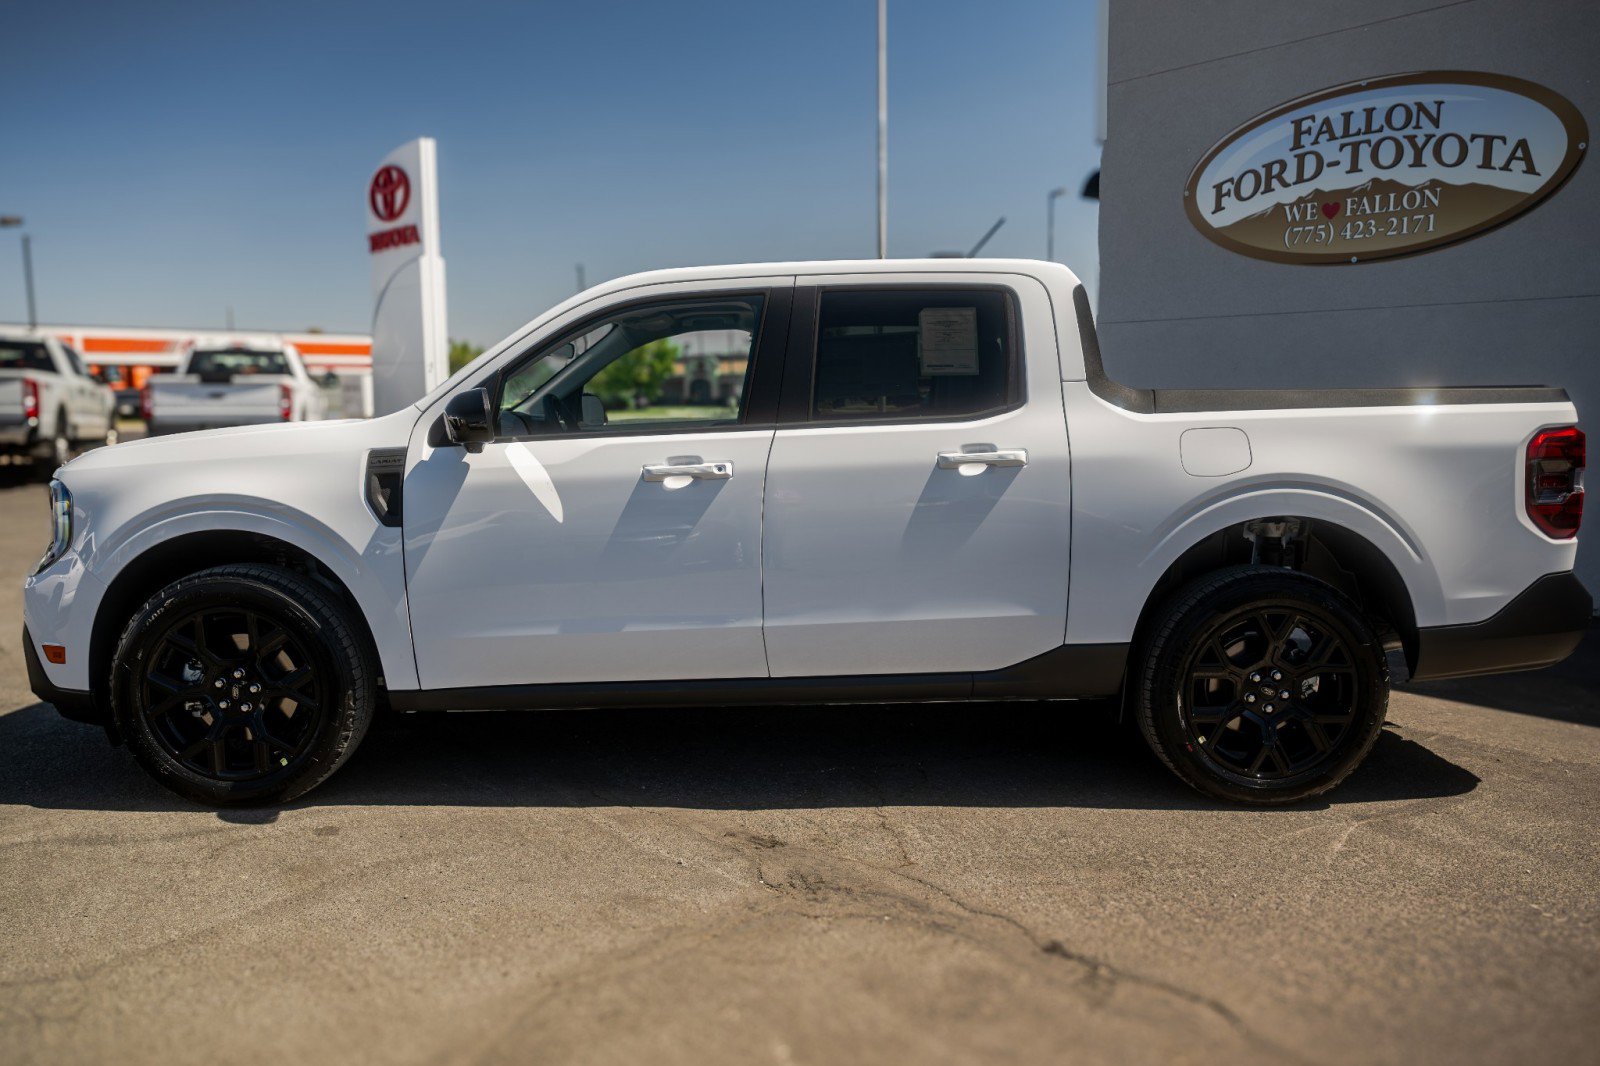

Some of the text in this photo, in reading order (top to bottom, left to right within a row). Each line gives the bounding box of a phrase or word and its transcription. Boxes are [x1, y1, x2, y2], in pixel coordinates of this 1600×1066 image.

[1289, 101, 1444, 151] FALLON
[1211, 133, 1541, 214] FORD-TOYOTA
[1284, 188, 1441, 223] WE FALLON
[1284, 214, 1436, 248] (775) 423-2171
